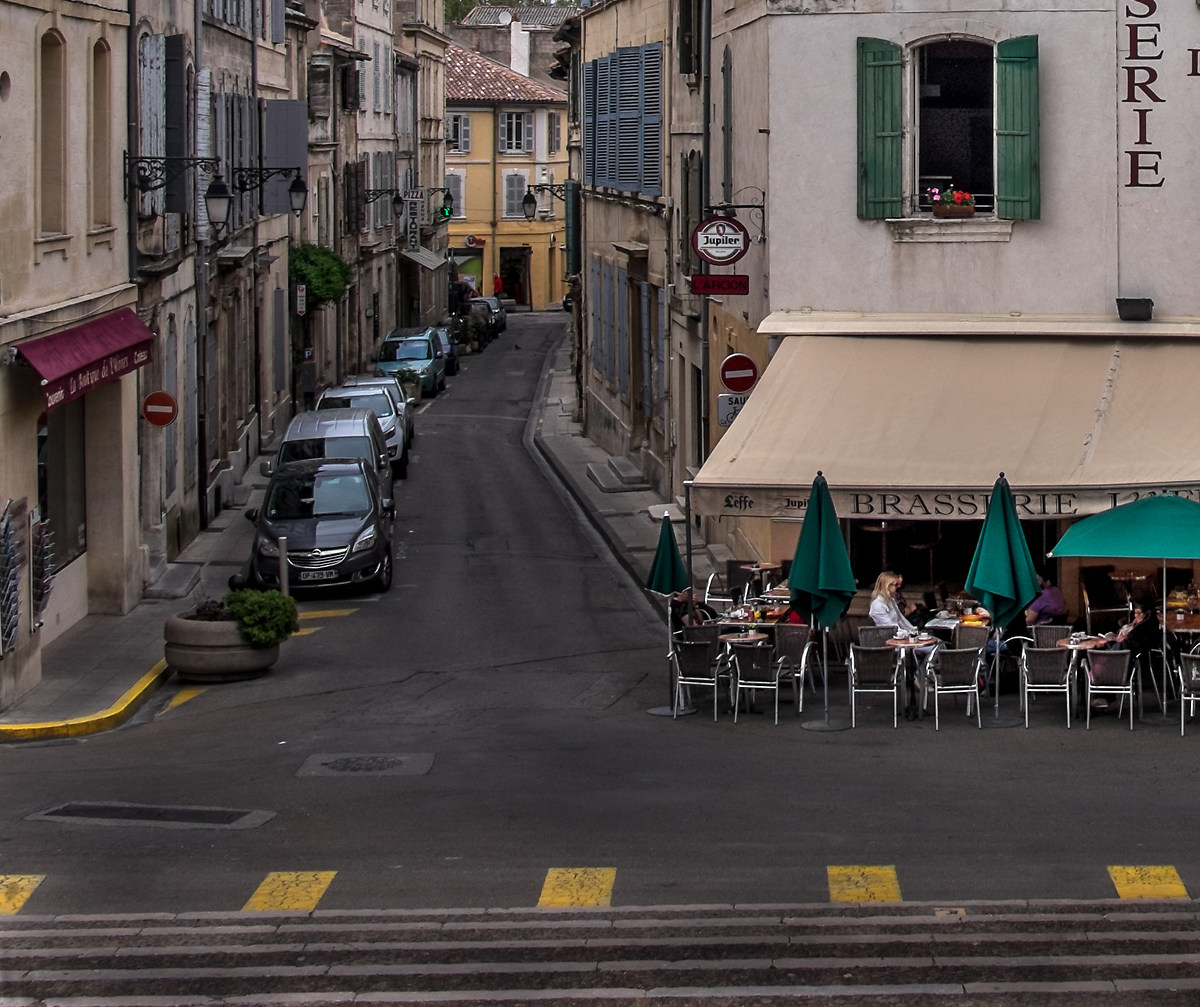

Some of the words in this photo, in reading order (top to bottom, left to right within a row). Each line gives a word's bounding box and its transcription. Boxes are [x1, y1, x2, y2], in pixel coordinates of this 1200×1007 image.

[403, 190, 424, 199] PIZZA
[703, 235, 740, 247] Jupiler
[693, 279, 747, 290] L'AFICION
[728, 397, 749, 406] SAU
[784, 498, 809, 509] Jupi
